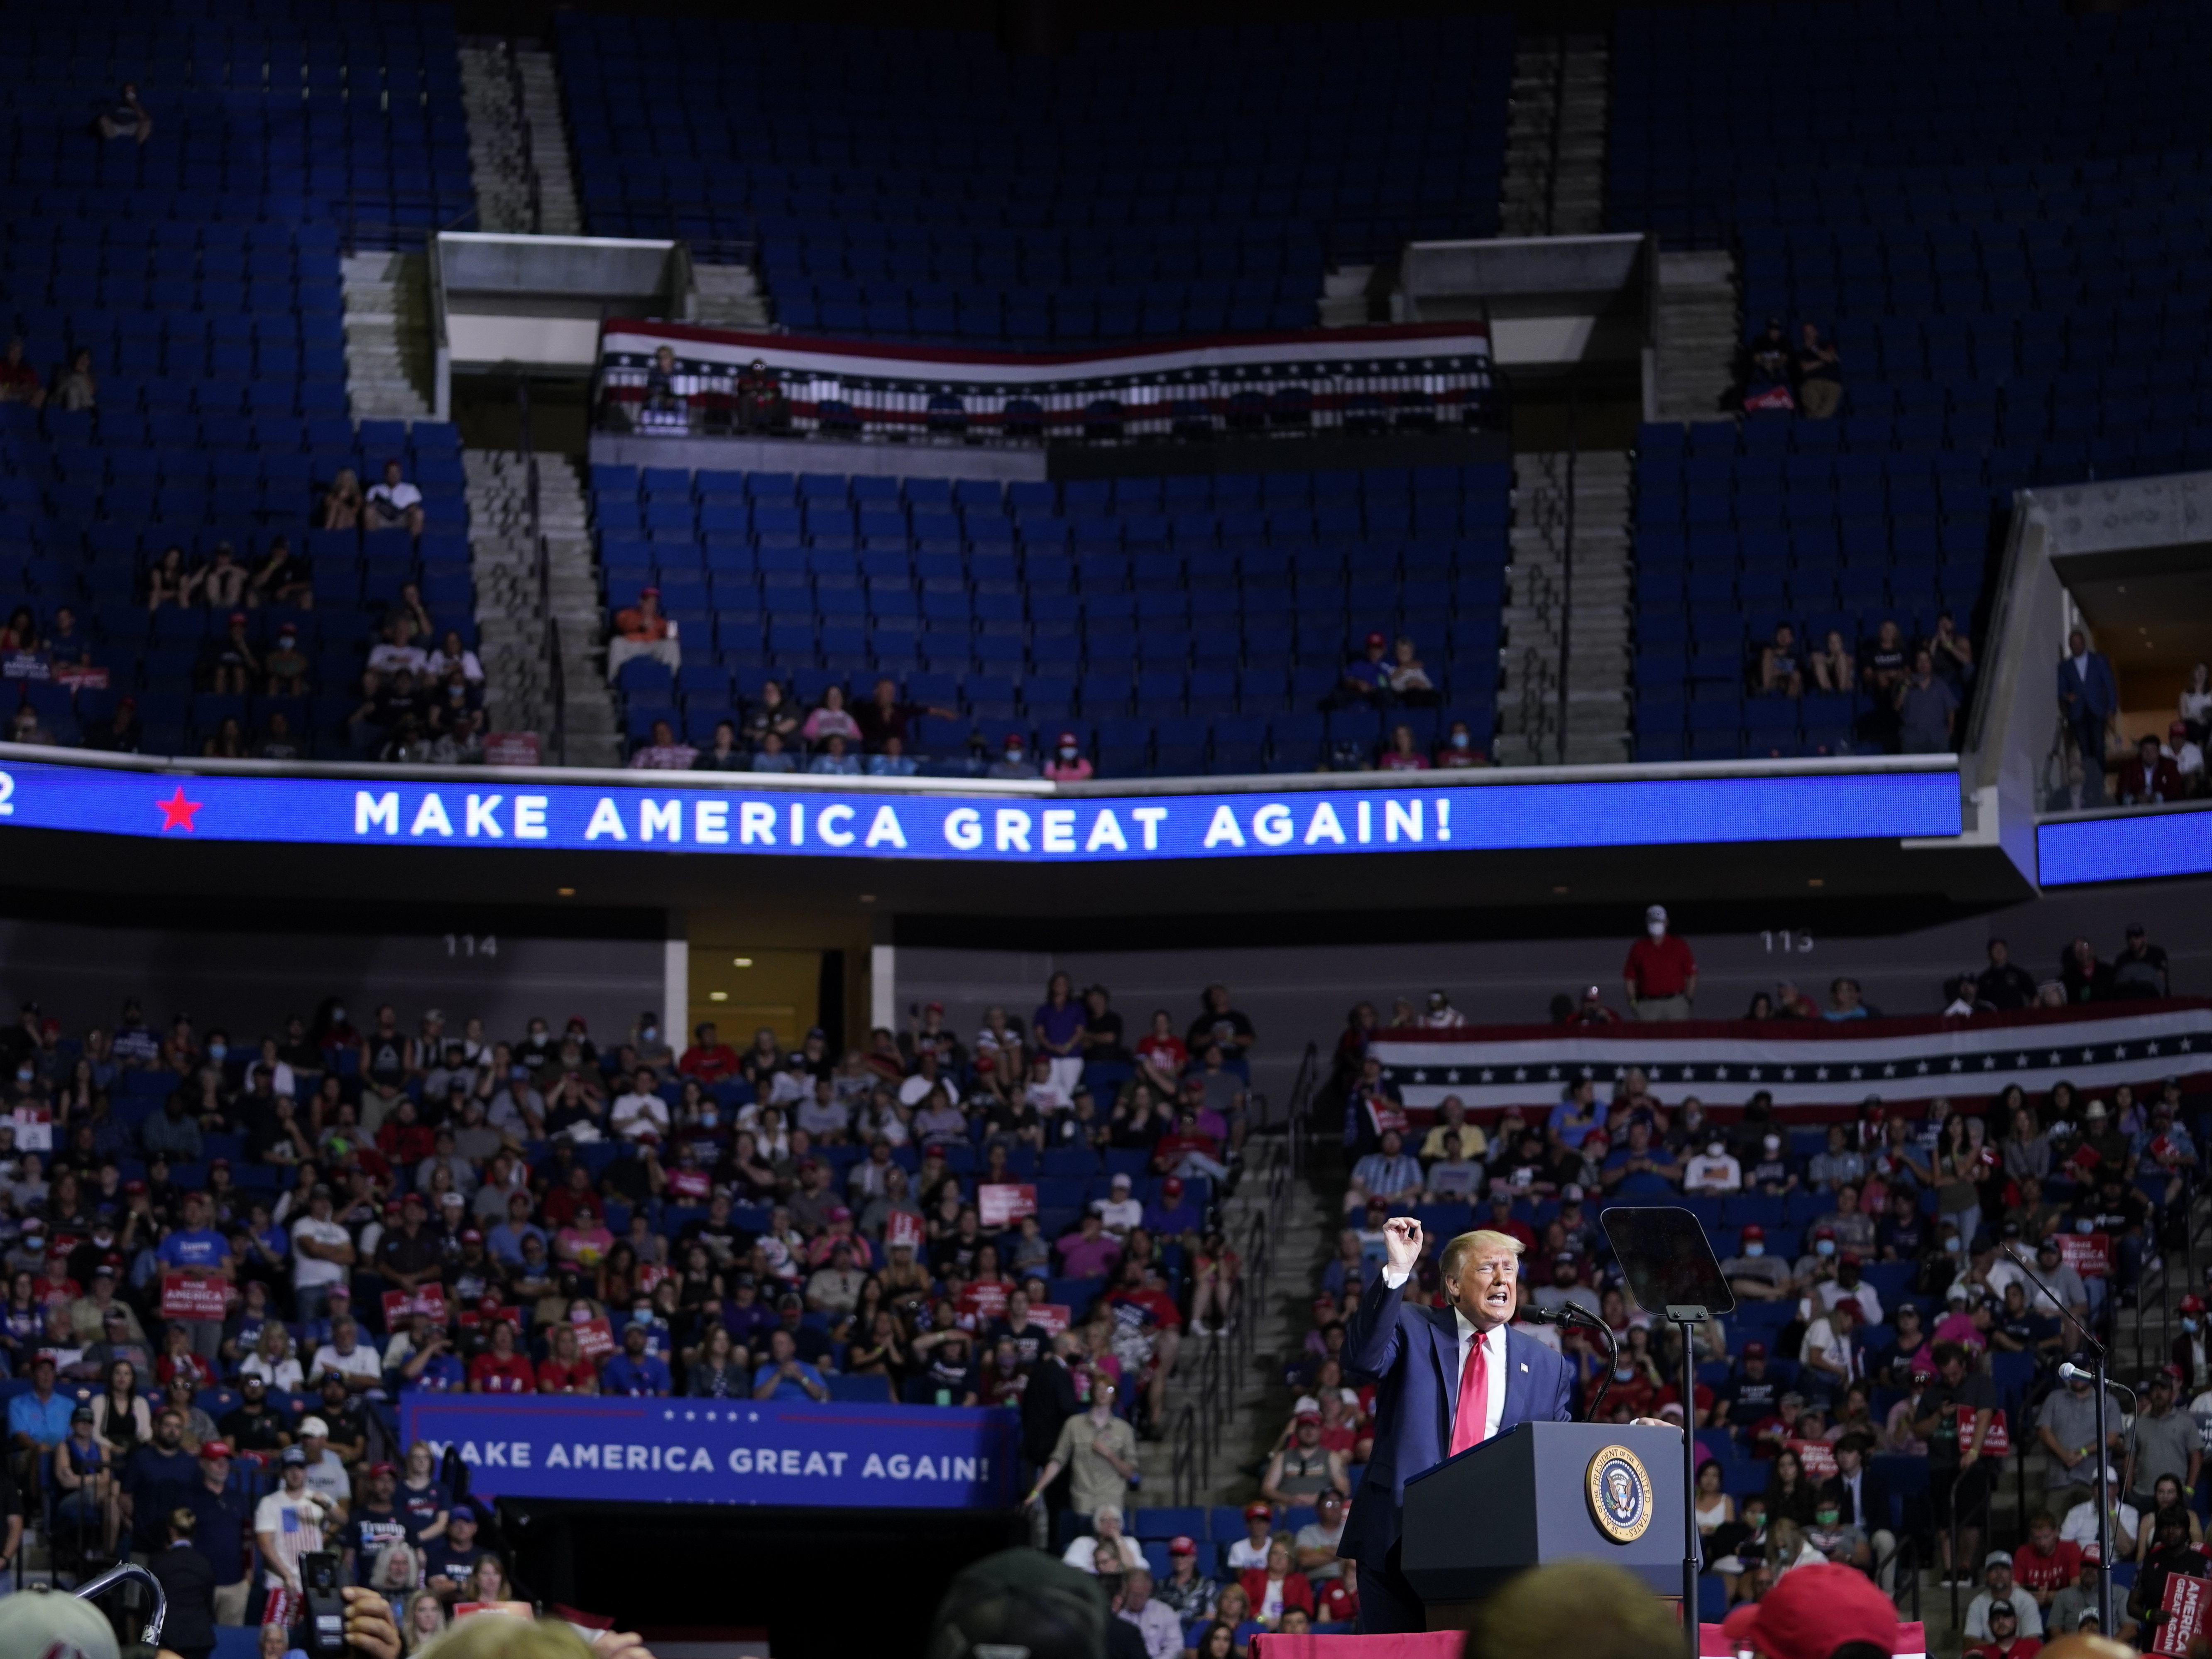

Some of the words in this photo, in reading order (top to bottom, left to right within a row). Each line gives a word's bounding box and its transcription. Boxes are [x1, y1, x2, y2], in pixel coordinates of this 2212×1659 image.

[354, 790, 548, 839] MAKE
[584, 797, 907, 849] AMERICA
[943, 807, 1168, 853] GREAT
[1203, 798, 1451, 849] AGAIN!
[444, 933, 498, 958] 114
[1759, 928, 1814, 954] 113
[2062, 1249, 2104, 1260] MERICA
[166, 1289, 223, 1301] AMERICA
[1960, 1422, 2005, 1437] AMCA
[546, 1443, 714, 1471] AMERICA
[729, 1448, 848, 1476] GREAT
[862, 1453, 990, 1483] AGAIN!
[1593, 1449, 1618, 1486] PRESIDENT
[1626, 1454, 1635, 1464] THE
[1636, 1464, 1650, 1503] UNITED
[1603, 1513, 1619, 1535] SEAL
[1629, 1511, 1649, 1537] STATES
[2171, 1578, 2186, 1616] GREAT
[2175, 1580, 2200, 1653] AMERICA
[2163, 1616, 2179, 1653] AGAIN
